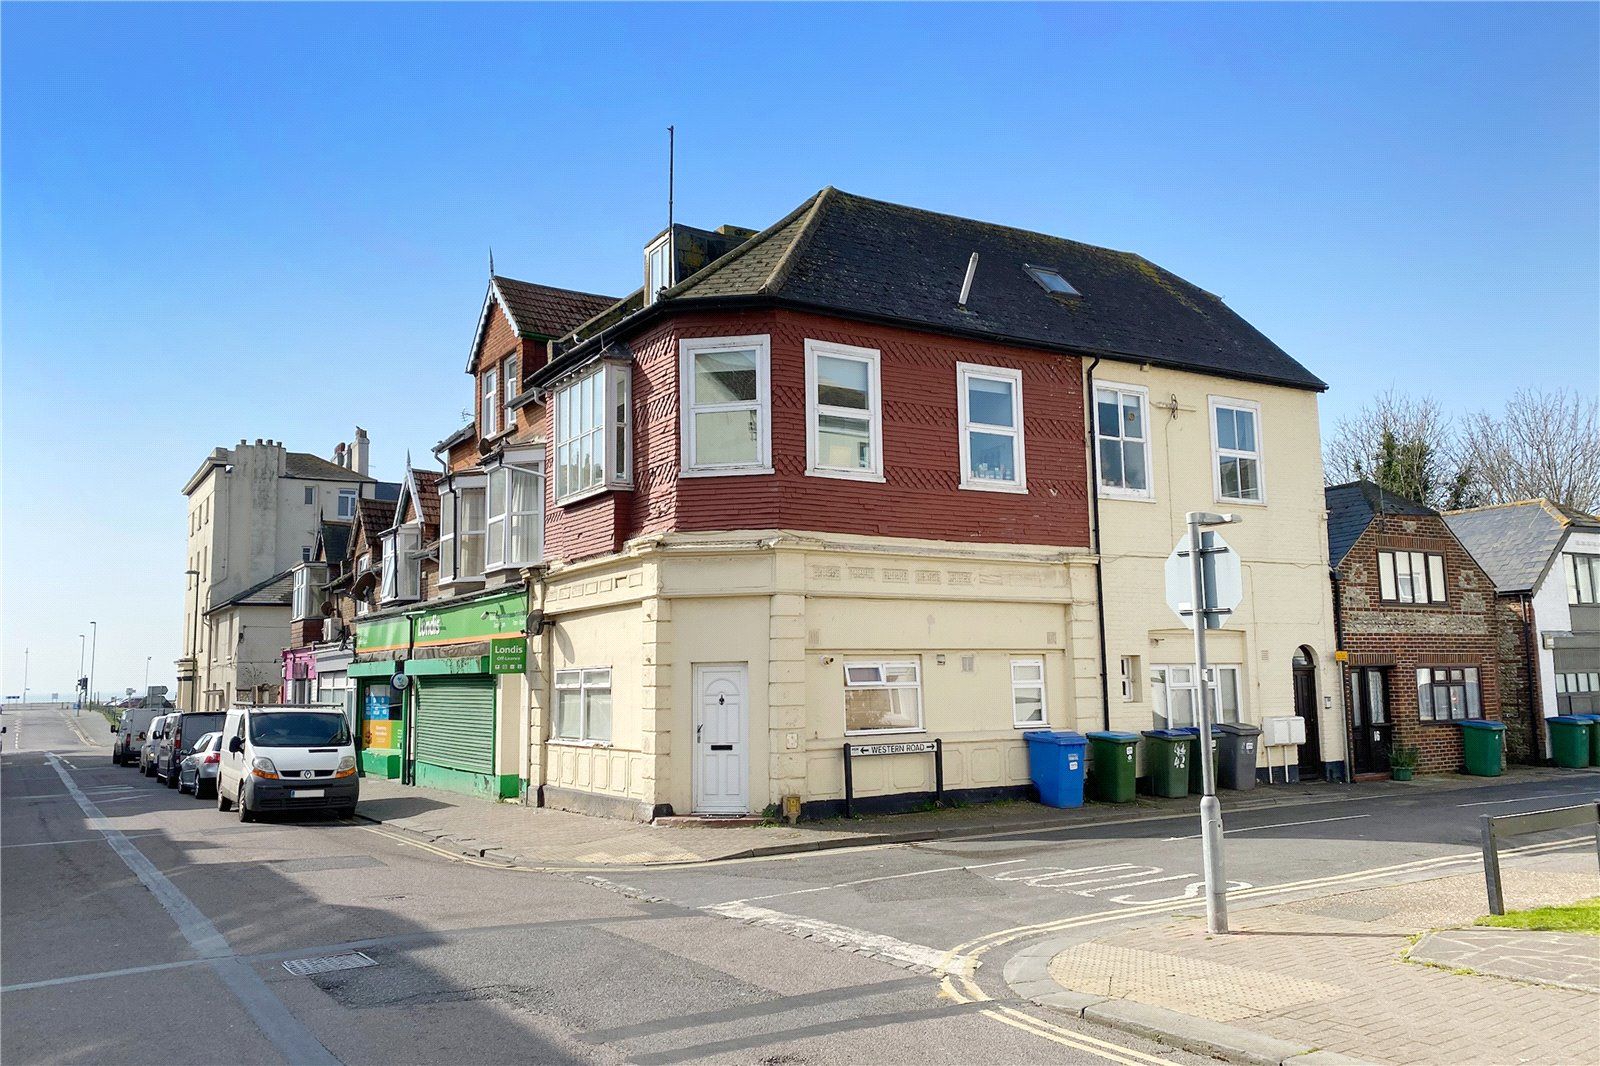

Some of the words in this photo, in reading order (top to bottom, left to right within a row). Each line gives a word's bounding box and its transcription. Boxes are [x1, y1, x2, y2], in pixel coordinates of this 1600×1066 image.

[495, 645, 523, 654] Londis
[871, 745, 905, 754] WESTERN
[906, 743, 925, 752] ROAD
[991, 863, 1254, 905] STOP
